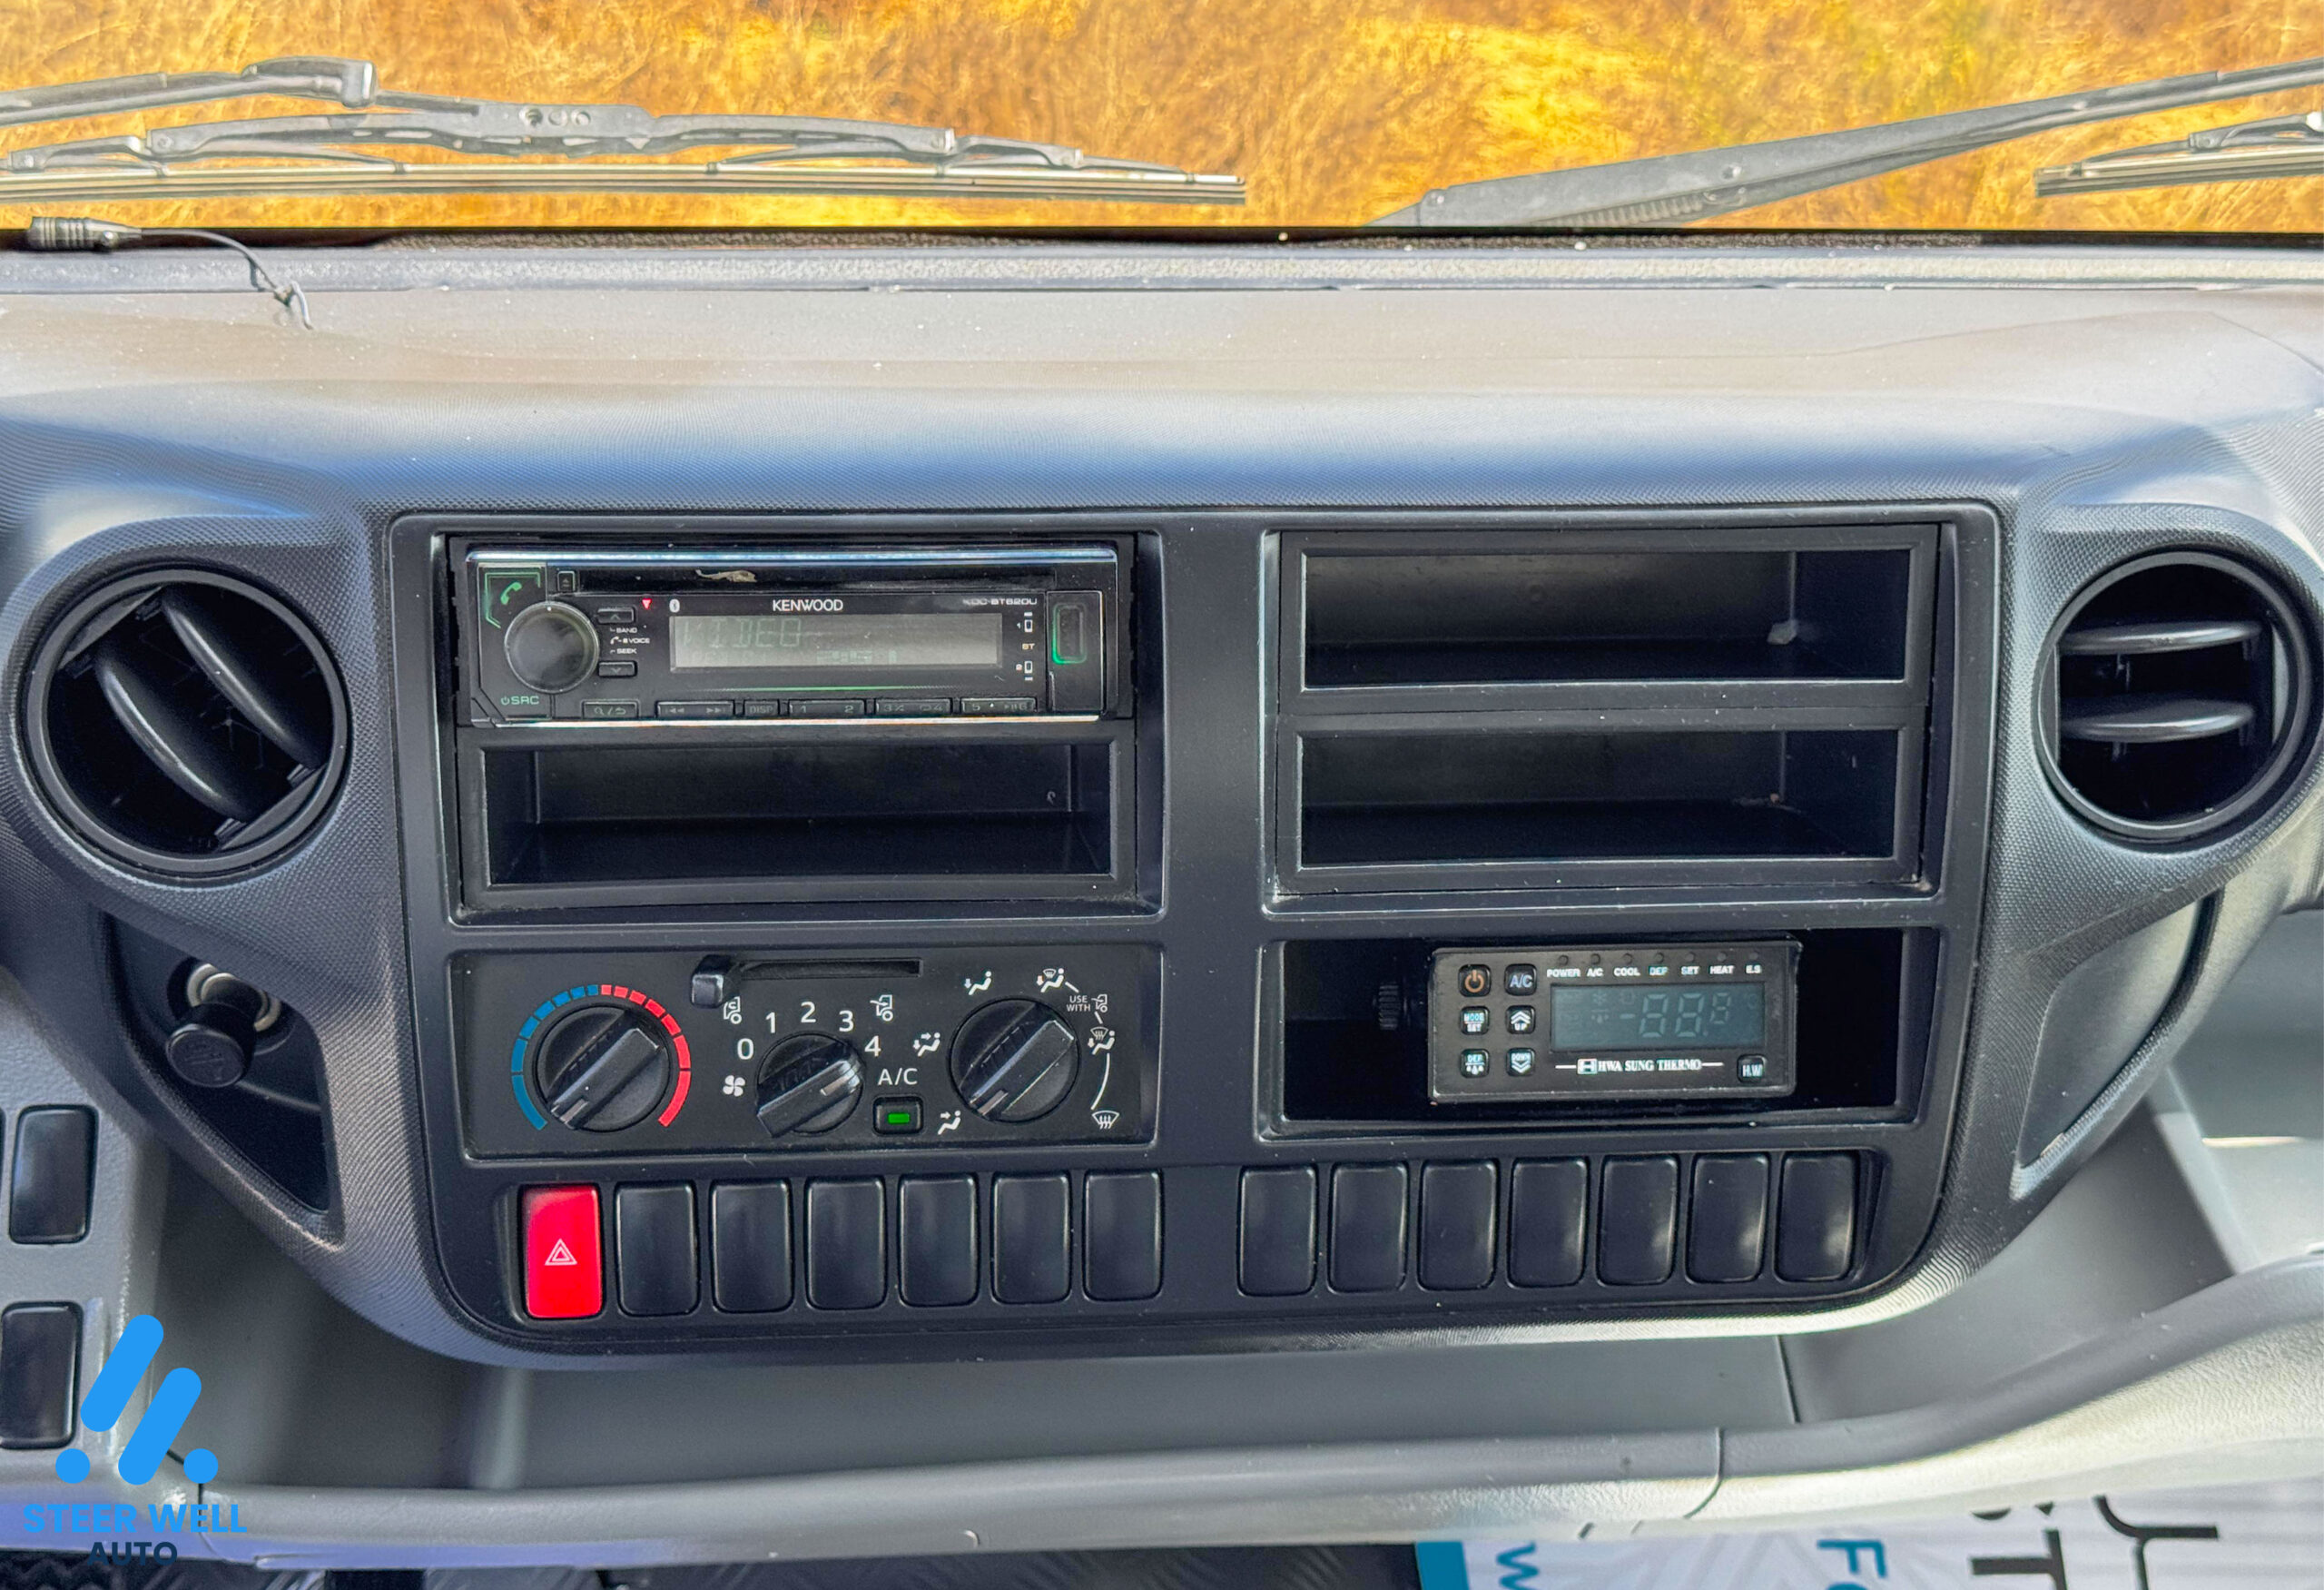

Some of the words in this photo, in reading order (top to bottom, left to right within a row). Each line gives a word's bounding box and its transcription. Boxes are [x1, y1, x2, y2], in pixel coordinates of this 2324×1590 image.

[773, 598, 844, 612] KENWOOD
[1546, 968, 1581, 978] POWER
[1587, 968, 1604, 977] A/C
[1613, 967, 1641, 977] COOL
[1681, 966, 1699, 975] SET
[1709, 965, 1735, 974] HEAT
[1510, 974, 1533, 989] A/C
[1068, 995, 1088, 1004] USE
[800, 1002, 817, 1023] 2
[1066, 1004, 1091, 1012] WITH
[765, 1012, 776, 1033] 1
[838, 1010, 854, 1032] 3
[1513, 1022, 1528, 1031] UP
[737, 1038, 754, 1061] 0
[864, 1036, 881, 1057] 4
[1511, 1052, 1531, 1062] DOWN
[1598, 1060, 1623, 1072] HWA
[1624, 1059, 1654, 1072] SUNG
[1656, 1059, 1702, 1072] THERMO
[878, 1067, 918, 1086] A/C
